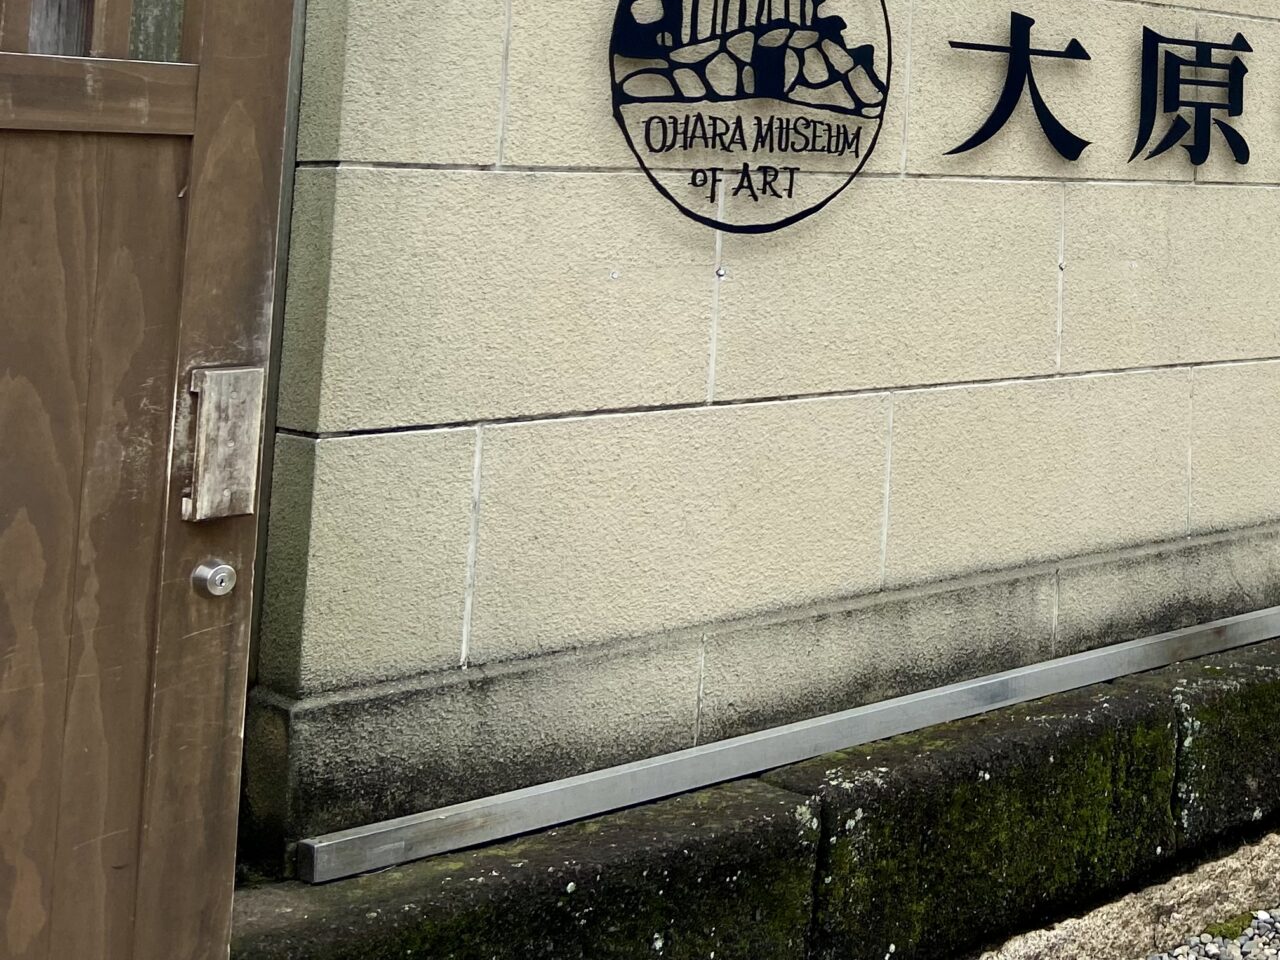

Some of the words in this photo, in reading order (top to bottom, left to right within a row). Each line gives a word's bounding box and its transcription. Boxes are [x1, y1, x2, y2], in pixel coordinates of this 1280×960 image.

[644, 112, 747, 152] OHARA
[752, 115, 862, 158] MUSEUM
[732, 162, 800, 202] ART
